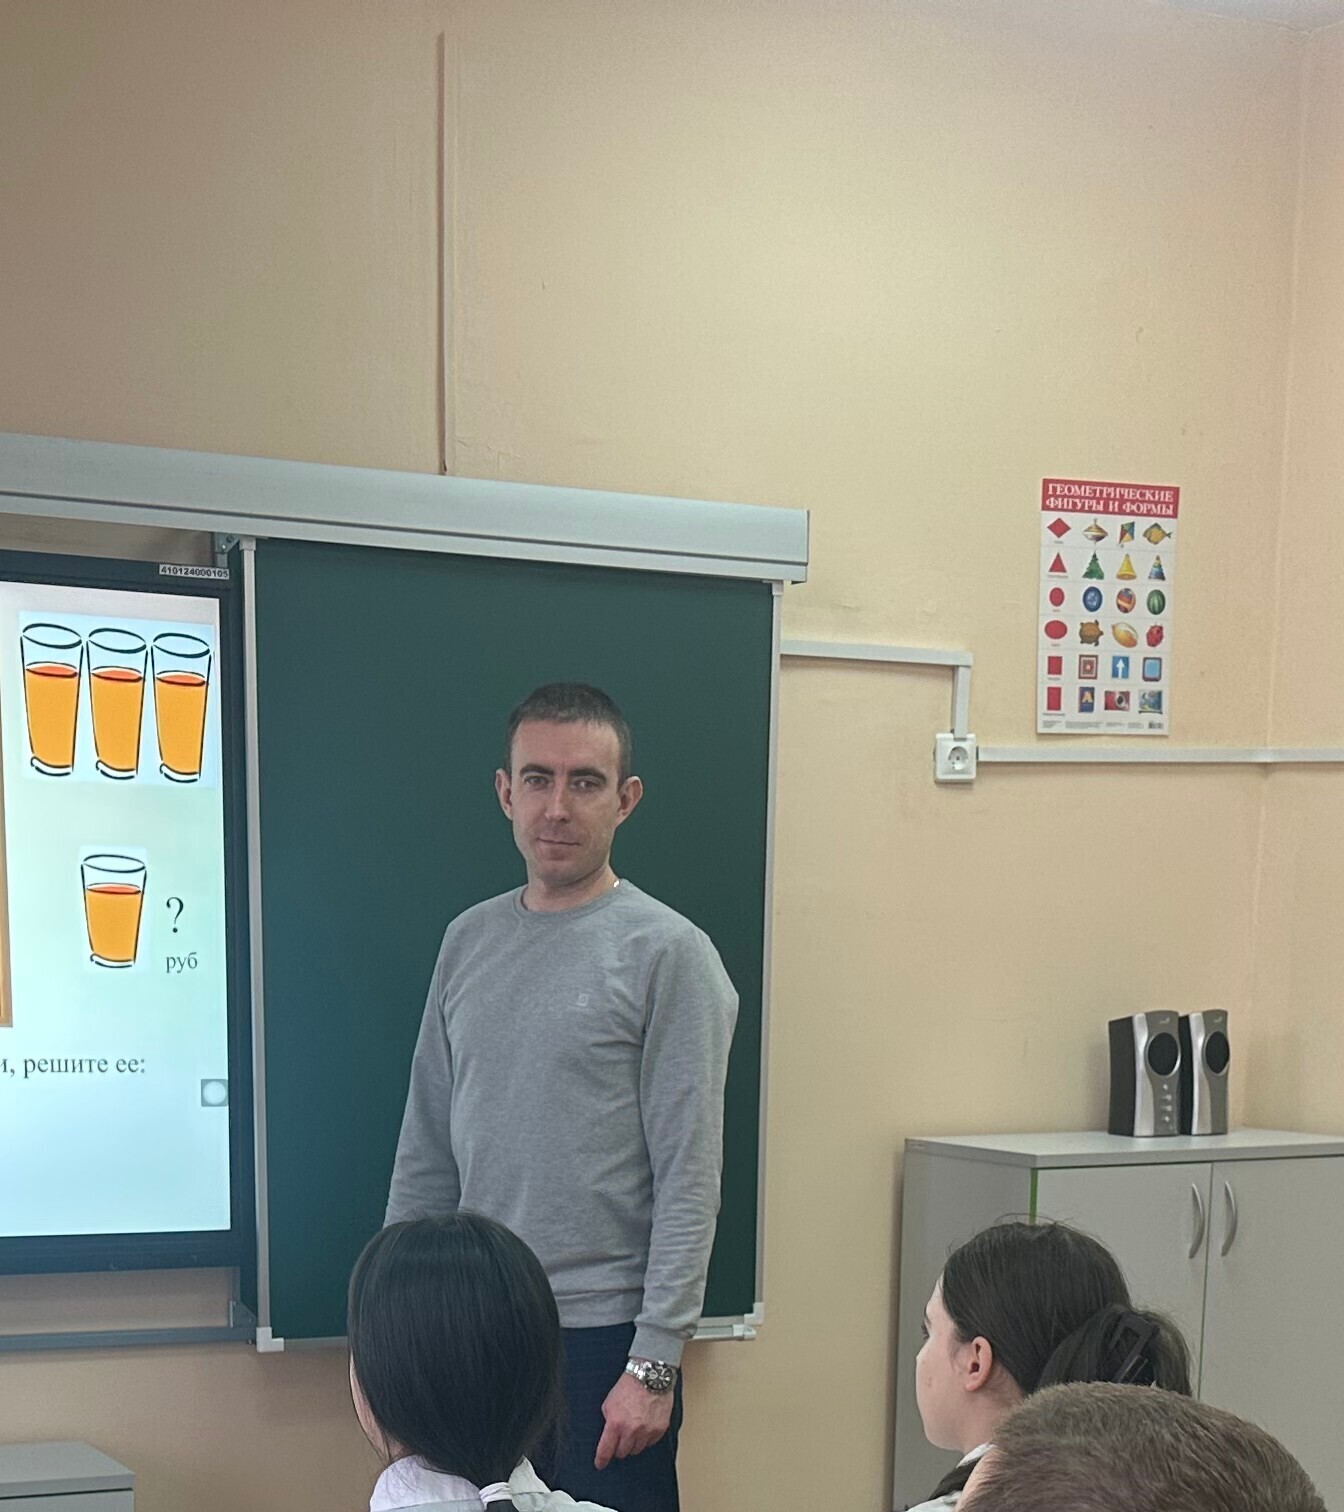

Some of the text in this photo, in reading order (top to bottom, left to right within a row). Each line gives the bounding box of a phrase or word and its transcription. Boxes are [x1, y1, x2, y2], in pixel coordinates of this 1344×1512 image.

[1048, 483, 1174, 502] ГЕОМЕТРИЧЕСКИЕ
[1046, 497, 1174, 516] ФИГУРЫ И ФОРМЫ
[166, 897, 184, 933] ?
[166, 952, 198, 973] руб
[23, 1057, 108, 1078] решите
[116, 1057, 146, 1073] ее:
